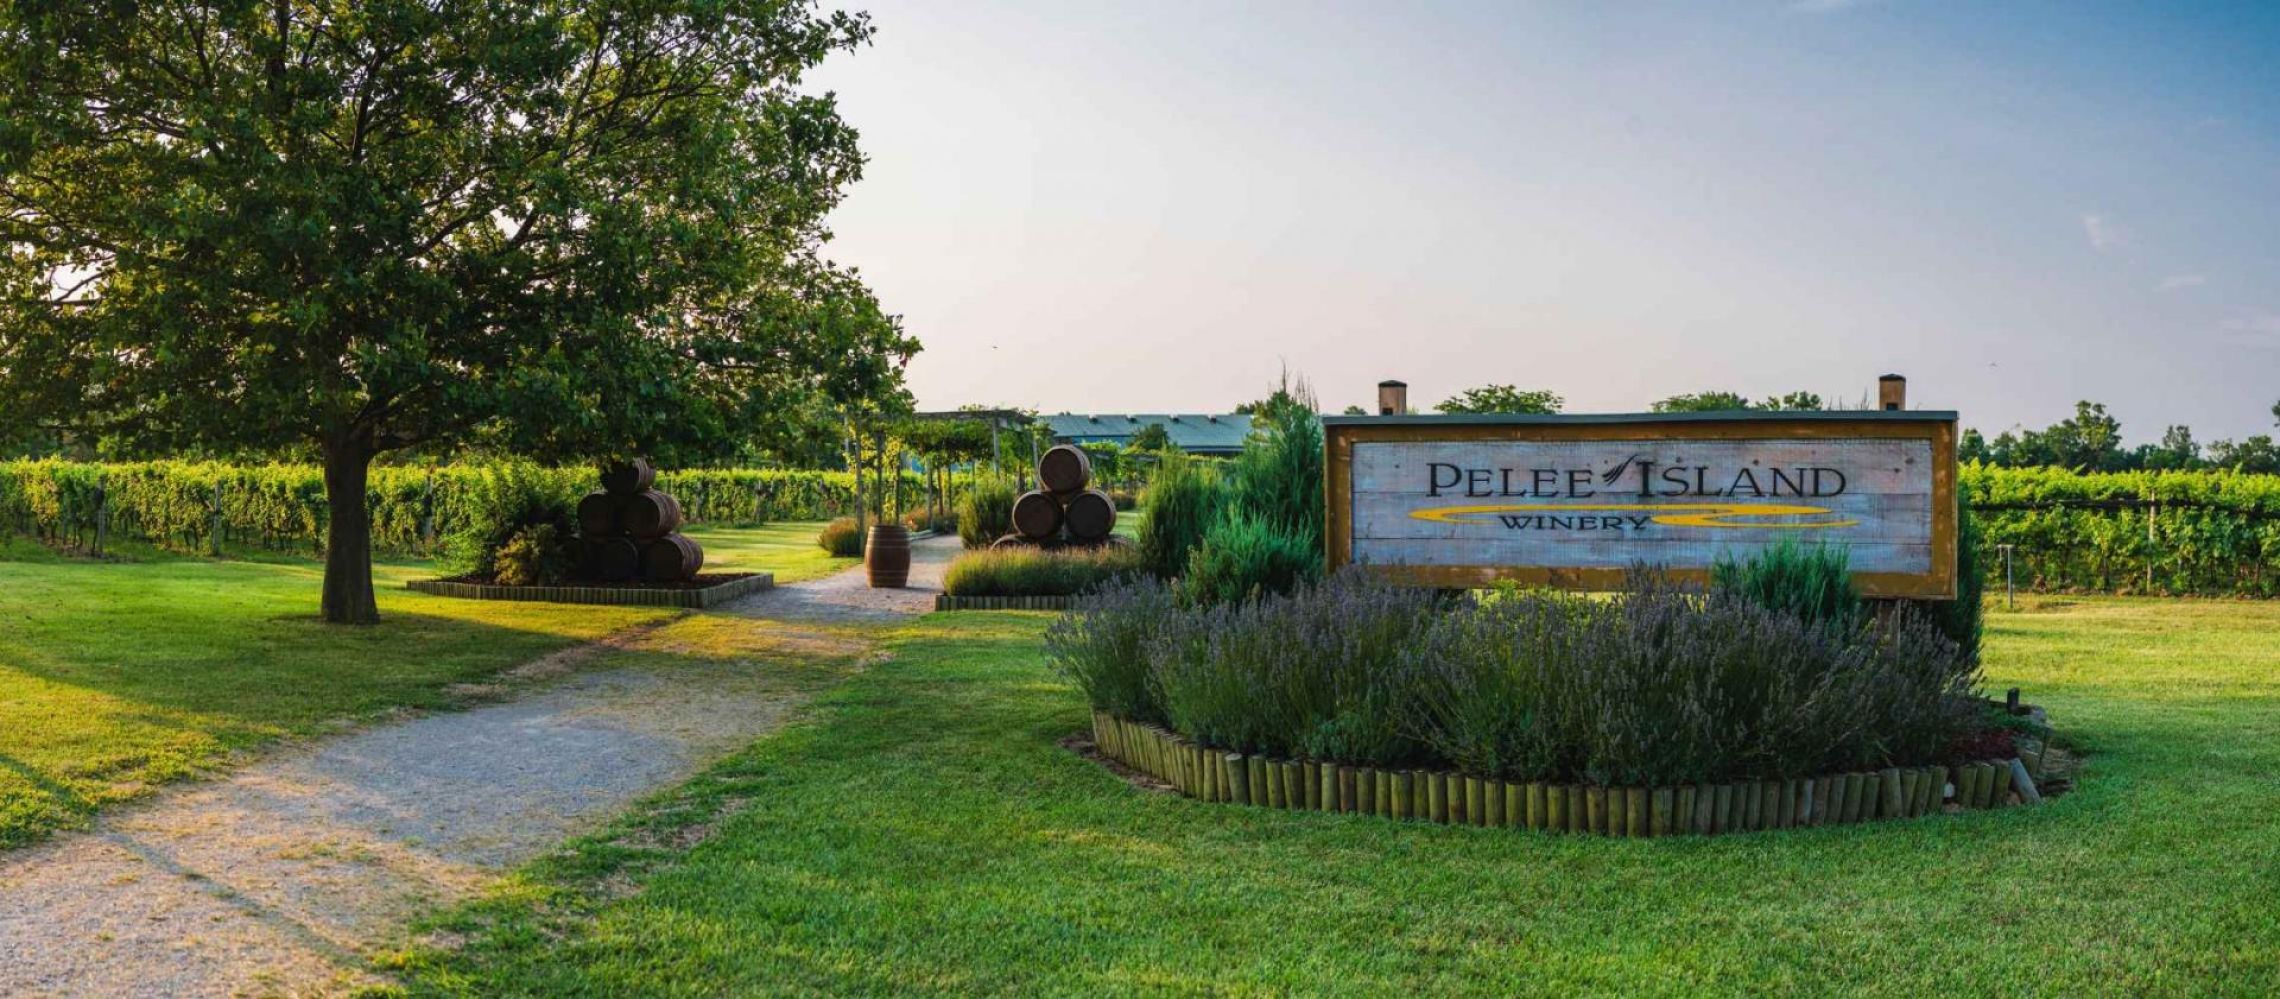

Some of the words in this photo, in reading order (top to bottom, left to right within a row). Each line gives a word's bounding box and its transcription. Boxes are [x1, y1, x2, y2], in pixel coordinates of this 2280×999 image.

[1426, 462, 1596, 498] PELEE
[1637, 461, 1847, 498] ISLAND
[1500, 515, 1651, 530] WINERY
